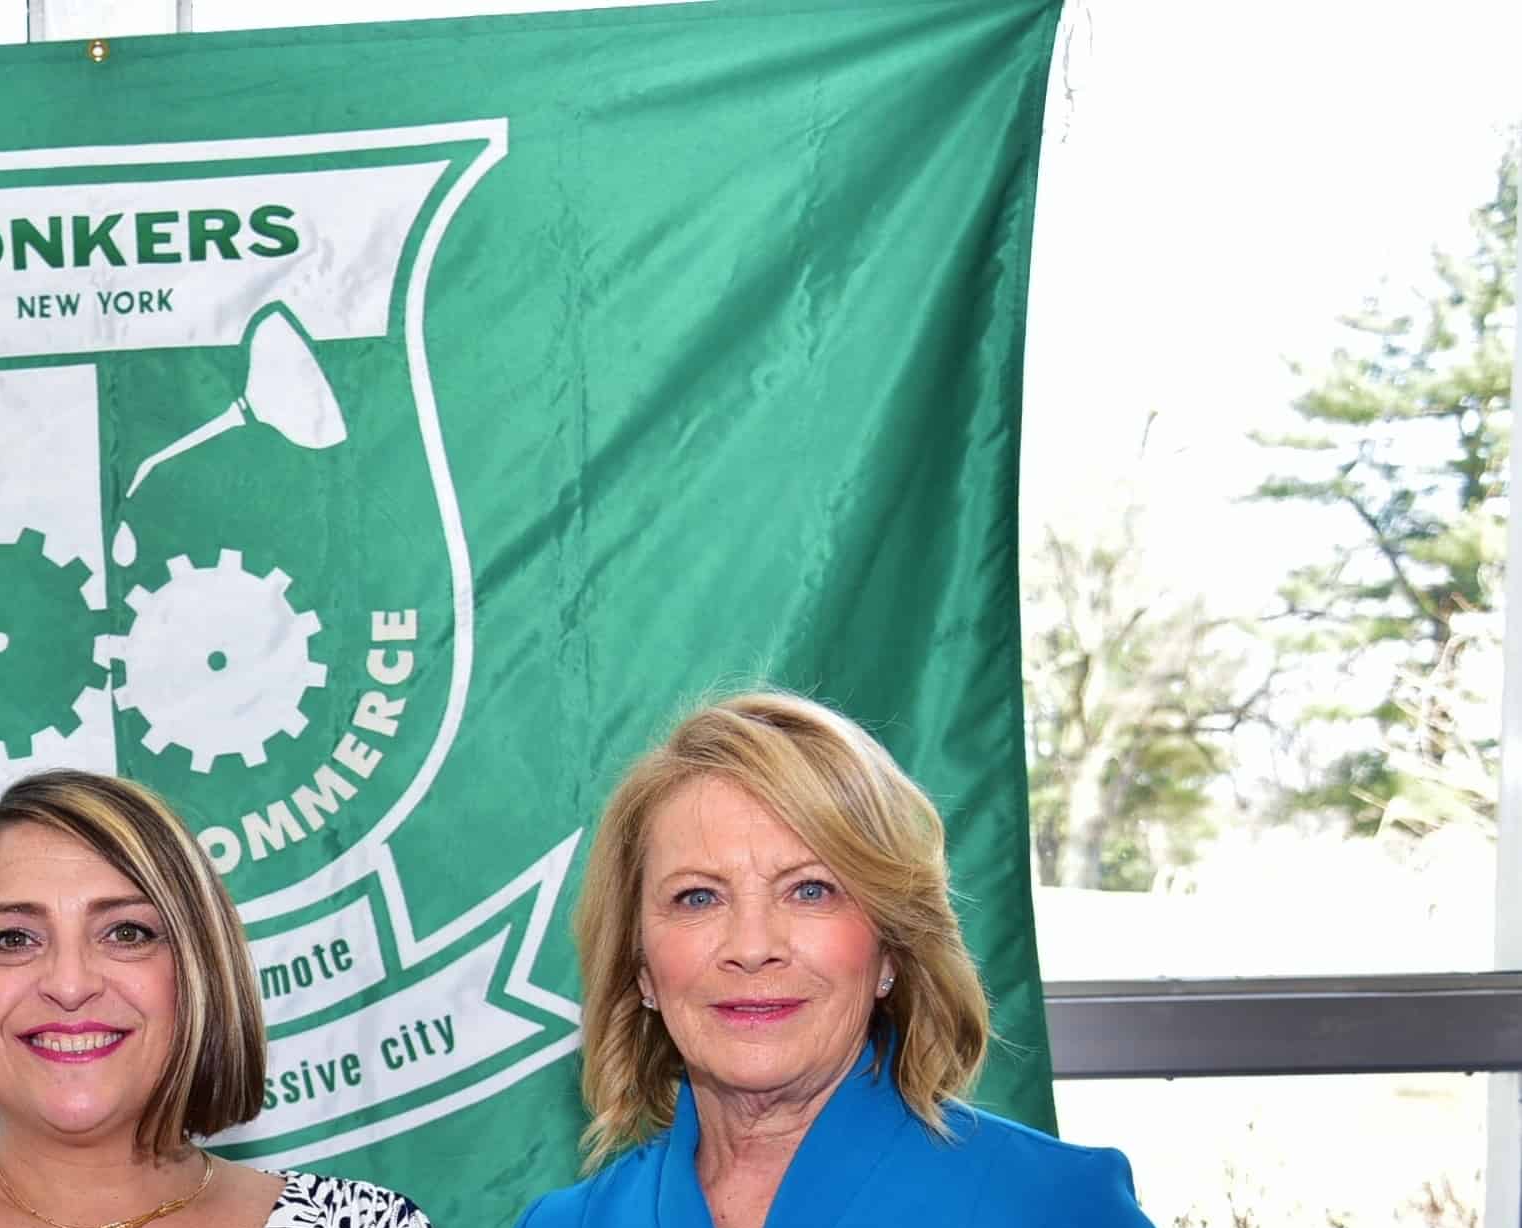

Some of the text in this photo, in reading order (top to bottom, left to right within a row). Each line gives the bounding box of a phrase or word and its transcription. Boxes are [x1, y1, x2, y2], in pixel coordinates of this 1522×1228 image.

[17, 288, 174, 319] NEW YORK
[194, 608, 418, 876] OMMERCE
[259, 937, 354, 1000] mote
[262, 1014, 455, 1111] ssive city
